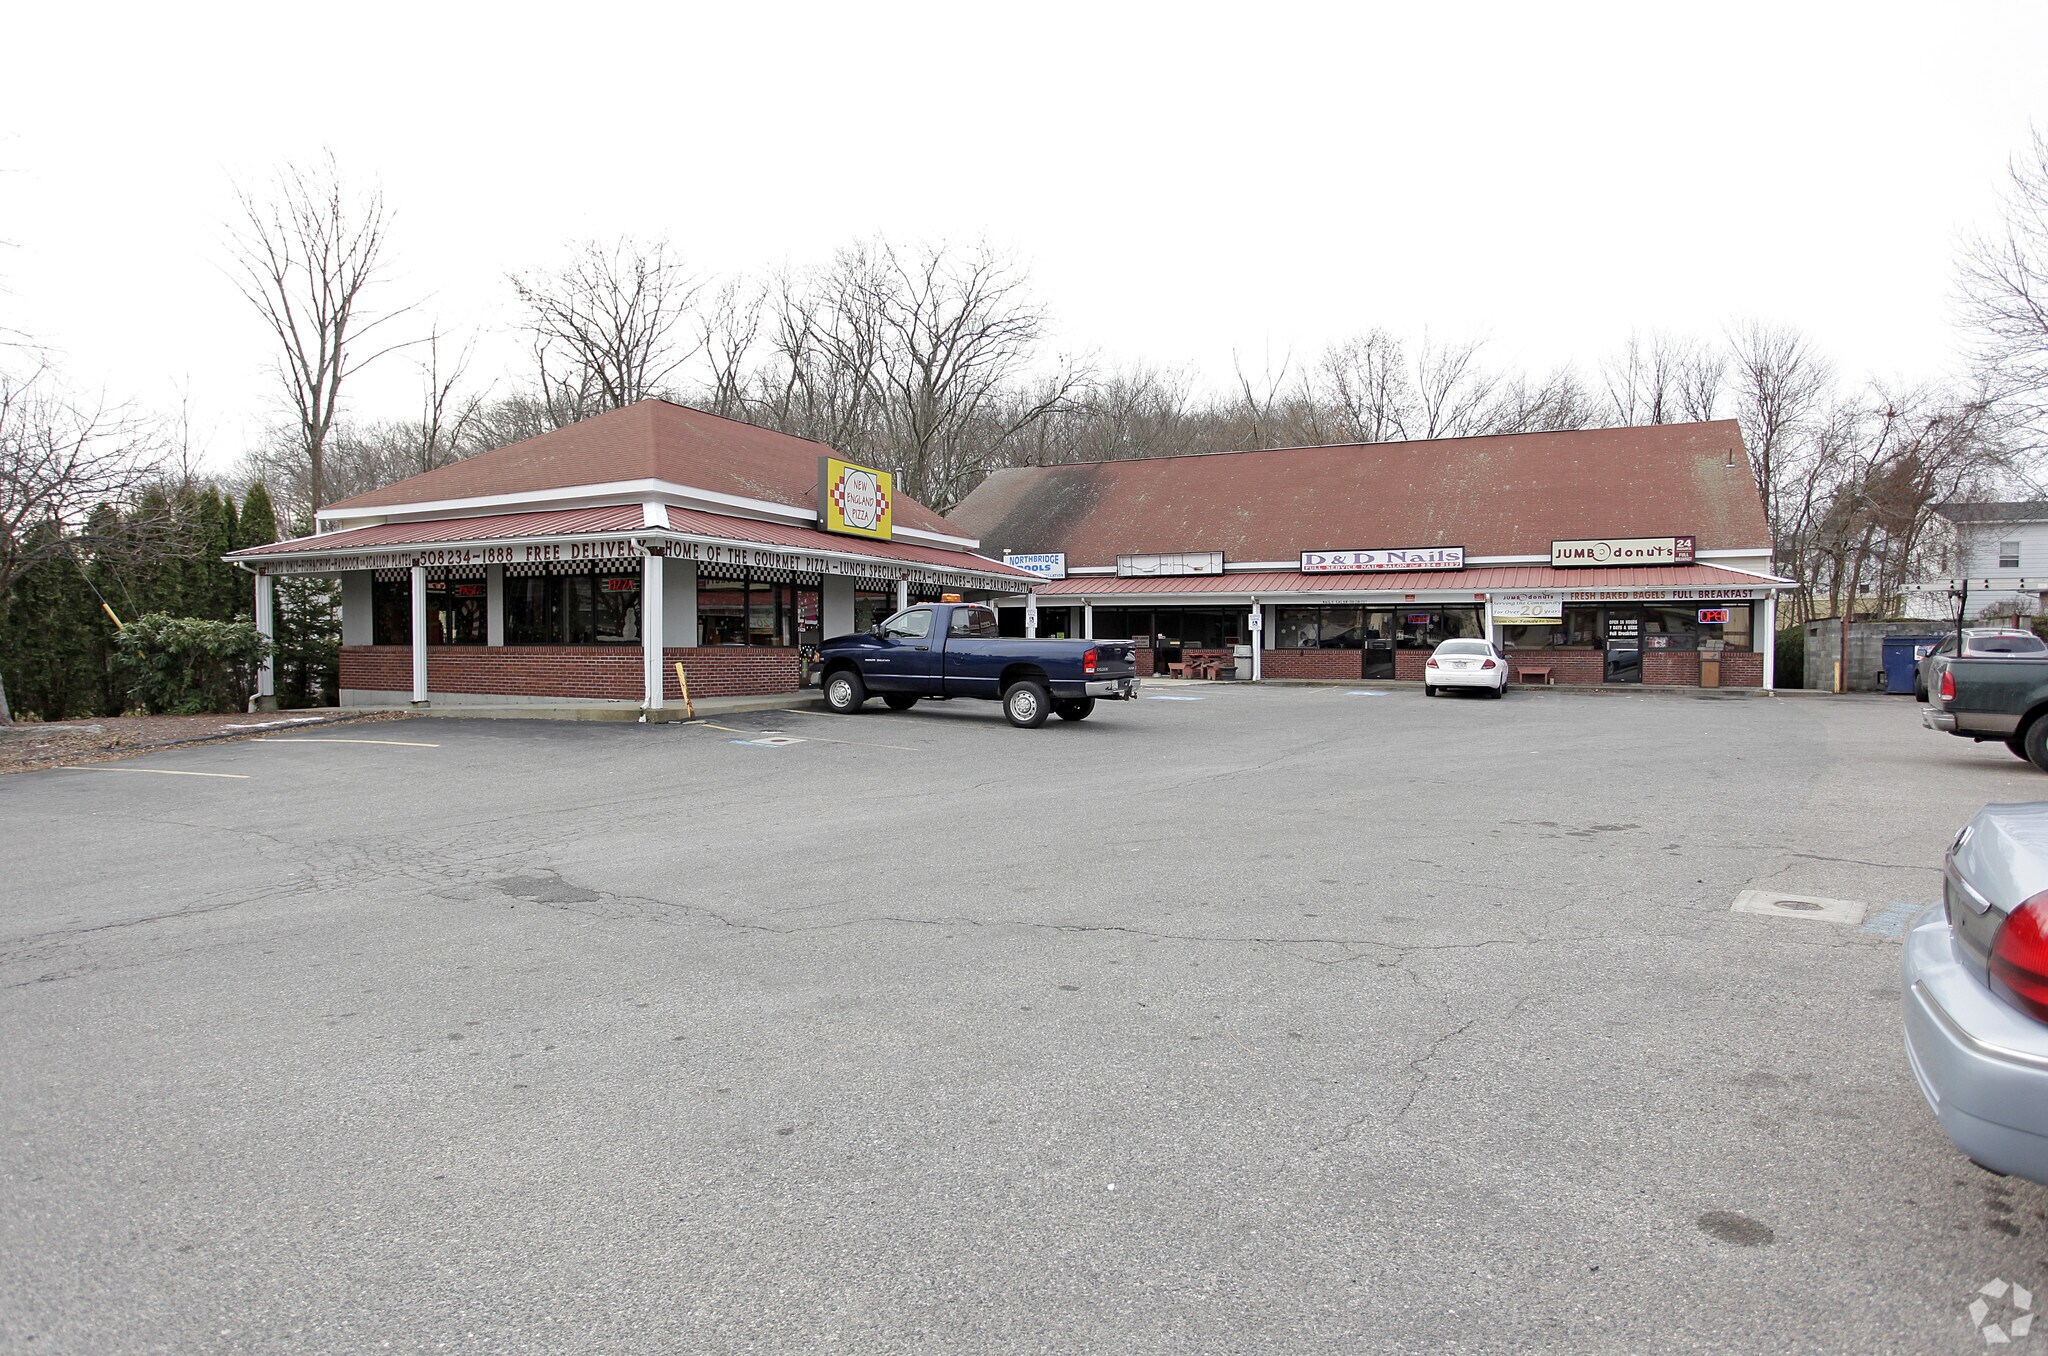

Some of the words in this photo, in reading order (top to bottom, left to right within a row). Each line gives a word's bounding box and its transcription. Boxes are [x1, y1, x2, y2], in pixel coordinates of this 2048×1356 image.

[854, 478, 867, 492] NEW
[847, 493, 874, 507] ENGLAND
[852, 508, 868, 521] PIZZA
[420, 551, 444, 565] 508
[447, 547, 513, 565] 234-1888
[526, 544, 560, 562] FREE
[571, 539, 646, 559] DELIVERY
[665, 540, 698, 559] HOME
[707, 546, 721, 561] OF
[728, 548, 747, 564] THE
[754, 551, 800, 569] GOURMET
[806, 557, 829, 573] PIZZA
[1387, 550, 1460, 563] Nails
[1614, 546, 1673, 557] donuts
[391, 553, 411, 567] PLATES
[1010, 555, 1059, 565] NORTHBRIDGE
[608, 579, 634, 590] PIZZA
[1570, 592, 1596, 600] FRESH
[1600, 592, 1628, 600] BAKED
[1633, 591, 1665, 599] BAGELS
[1673, 590, 1693, 599] FULL
[1698, 589, 1753, 598] BREAKFAST
[1520, 605, 1543, 616] 20
[1701, 610, 1727, 622] OPEN
